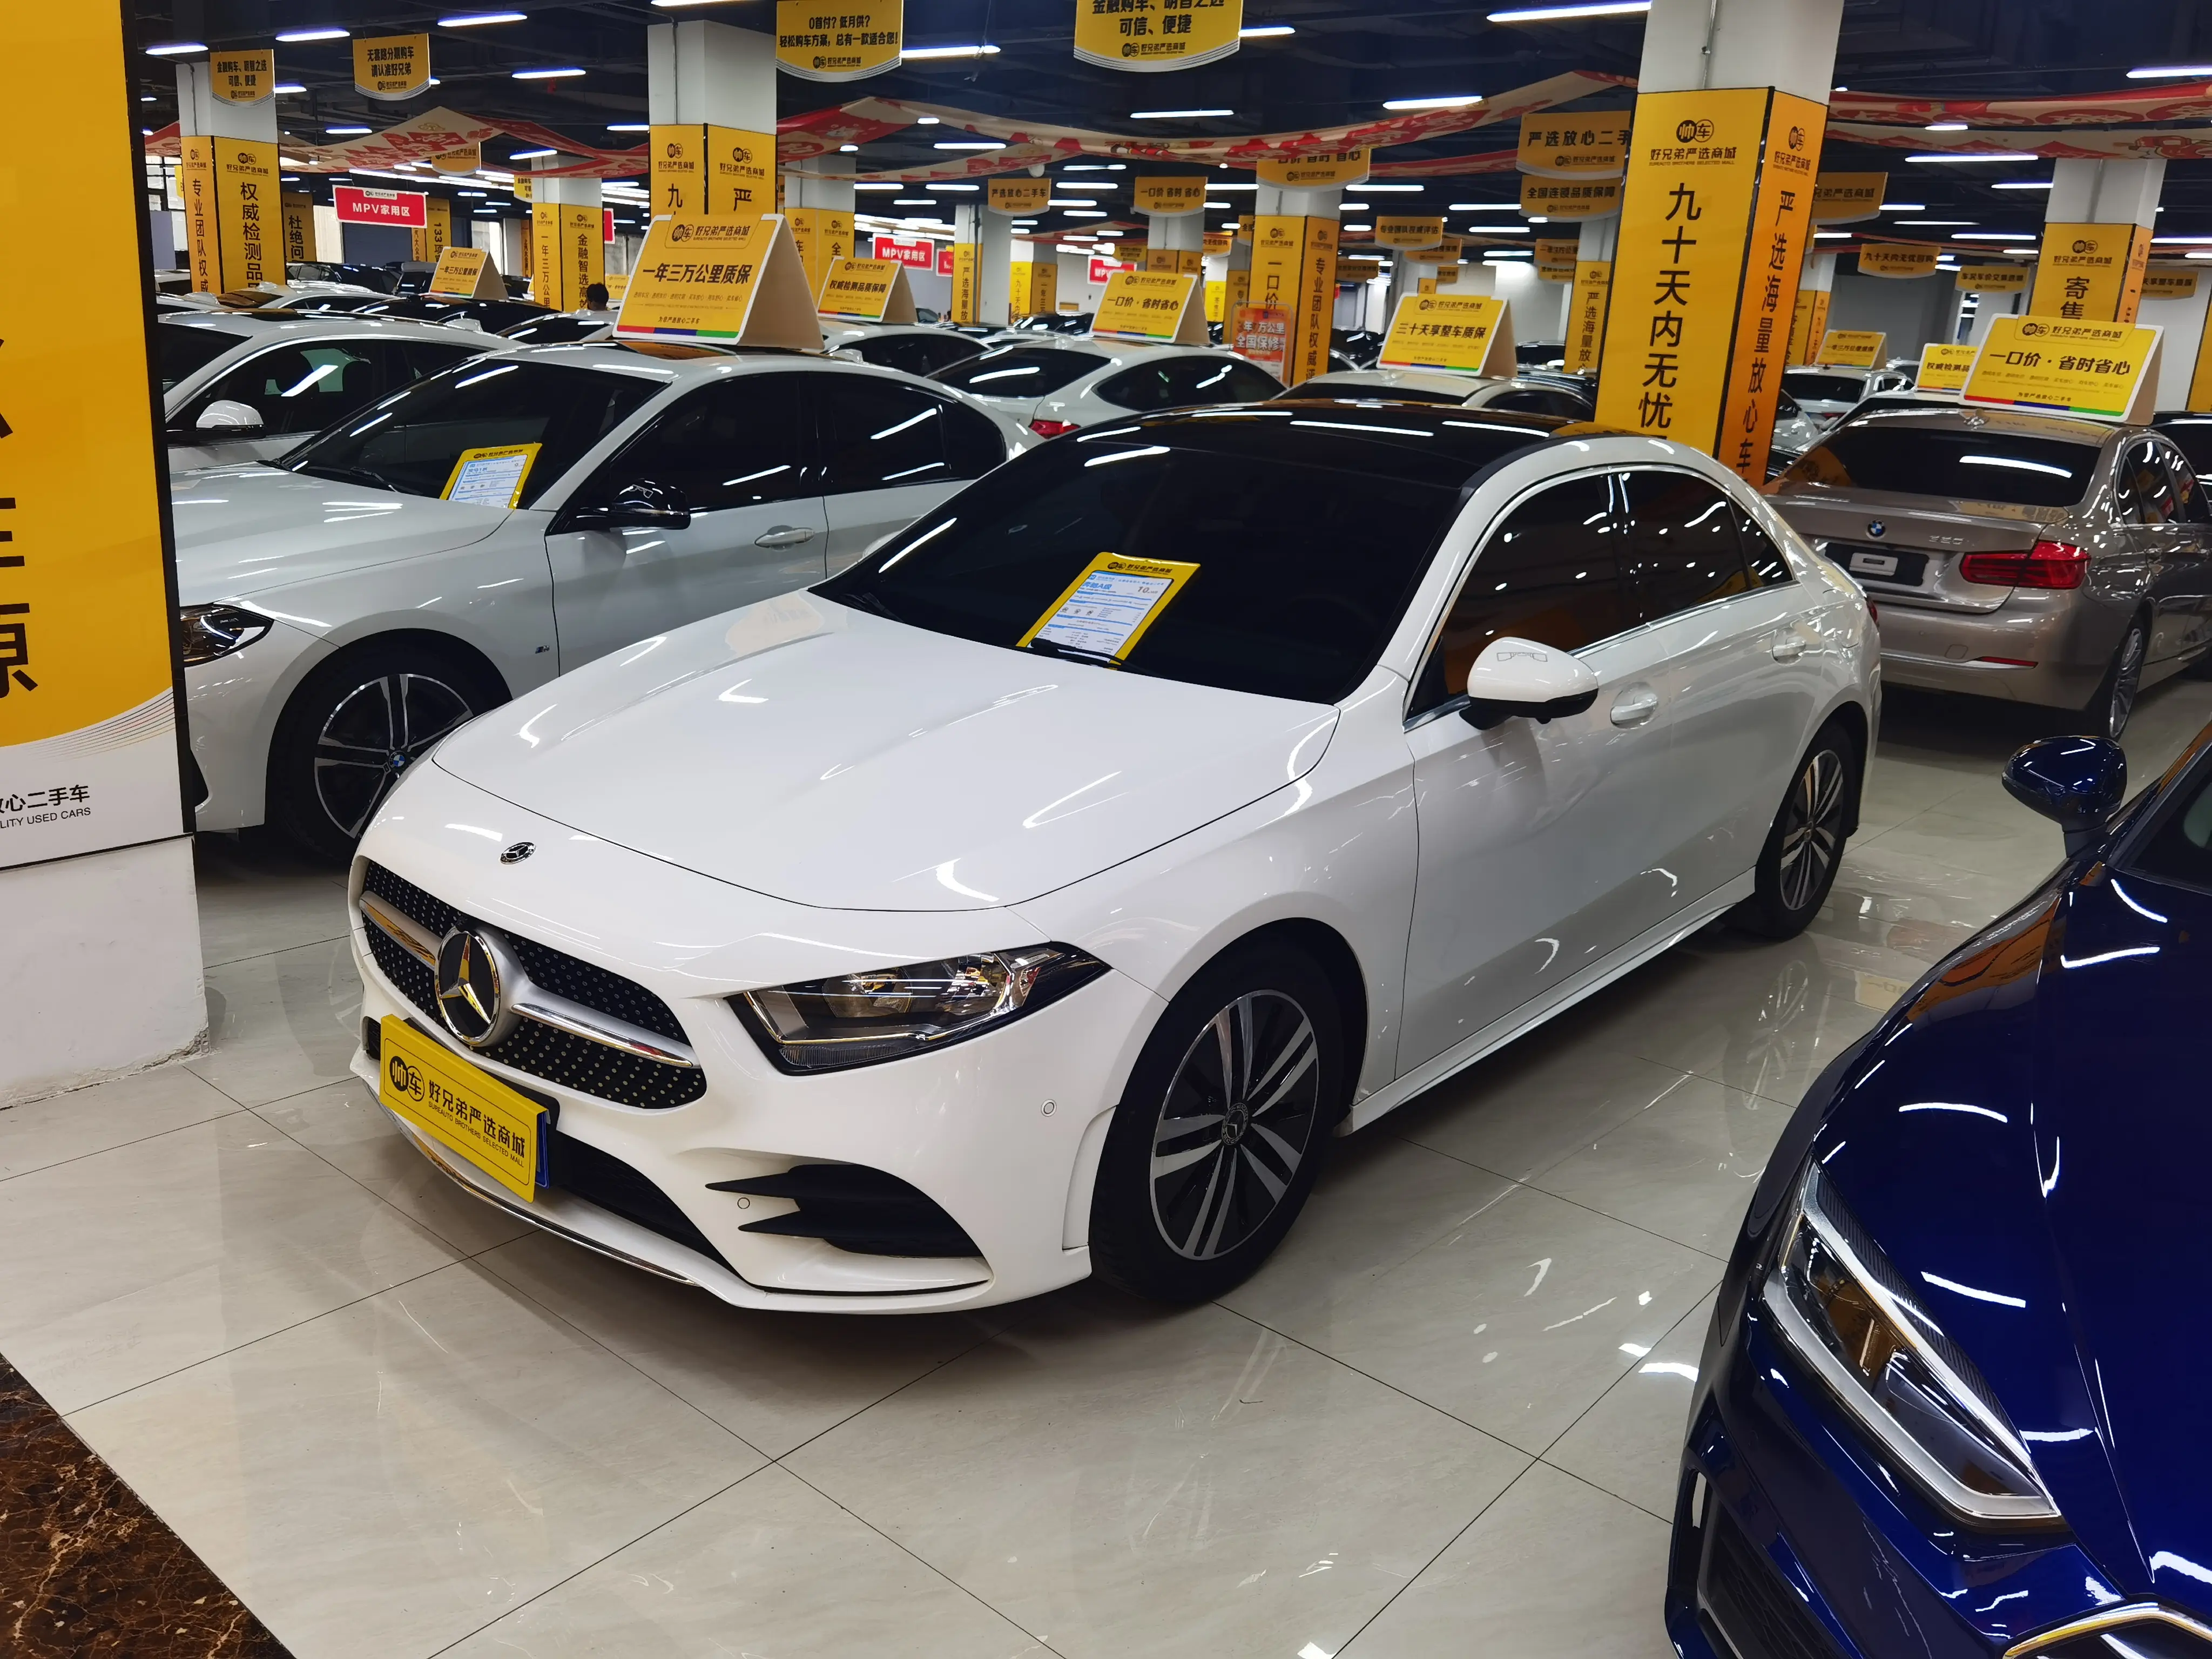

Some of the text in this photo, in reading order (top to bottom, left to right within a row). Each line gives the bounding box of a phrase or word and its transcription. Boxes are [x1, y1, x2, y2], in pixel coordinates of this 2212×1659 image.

[1119, 15, 1192, 36] 可信、便捷
[367, 46, 414, 62] 无套路分期购车
[371, 62, 412, 77] 请认准好兄弟
[1676, 119, 1714, 143] 帅车
[1650, 146, 1737, 161] 好兄弟严选商城
[227, 164, 268, 174] 好兄弟严选商城
[658, 161, 694, 170] 好兄弟严选商城
[720, 163, 765, 176] 好兄弟严选商城
[733, 188, 752, 211] 严
[1527, 186, 1615, 199] 全国连锁品质保障
[352, 203, 410, 217] MPV家用区
[288, 215, 304, 262] 杜绝问
[695, 225, 751, 237] 好兄弟严选商城
[882, 247, 925, 262] MPV家用区
[643, 263, 753, 284] 一年三万公里质保
[830, 279, 887, 293] 权威检测品质保障
[1638, 183, 1702, 440] 九十天内无忧
[1397, 323, 1487, 340] 三十天享整车质保
[1578, 292, 1600, 369] 严选海量放
[1736, 190, 1796, 482] 严选海量放心车
[2051, 326, 2123, 339] 好兄弟严选商城
[27, 813, 57, 824] USED
[61, 807, 91, 819] CARS
[389, 1055, 525, 1159] 帅车 好兄弟严选商城
[428, 1101, 524, 1168] SUREAUTO BROTHERS SELECTED MALL
